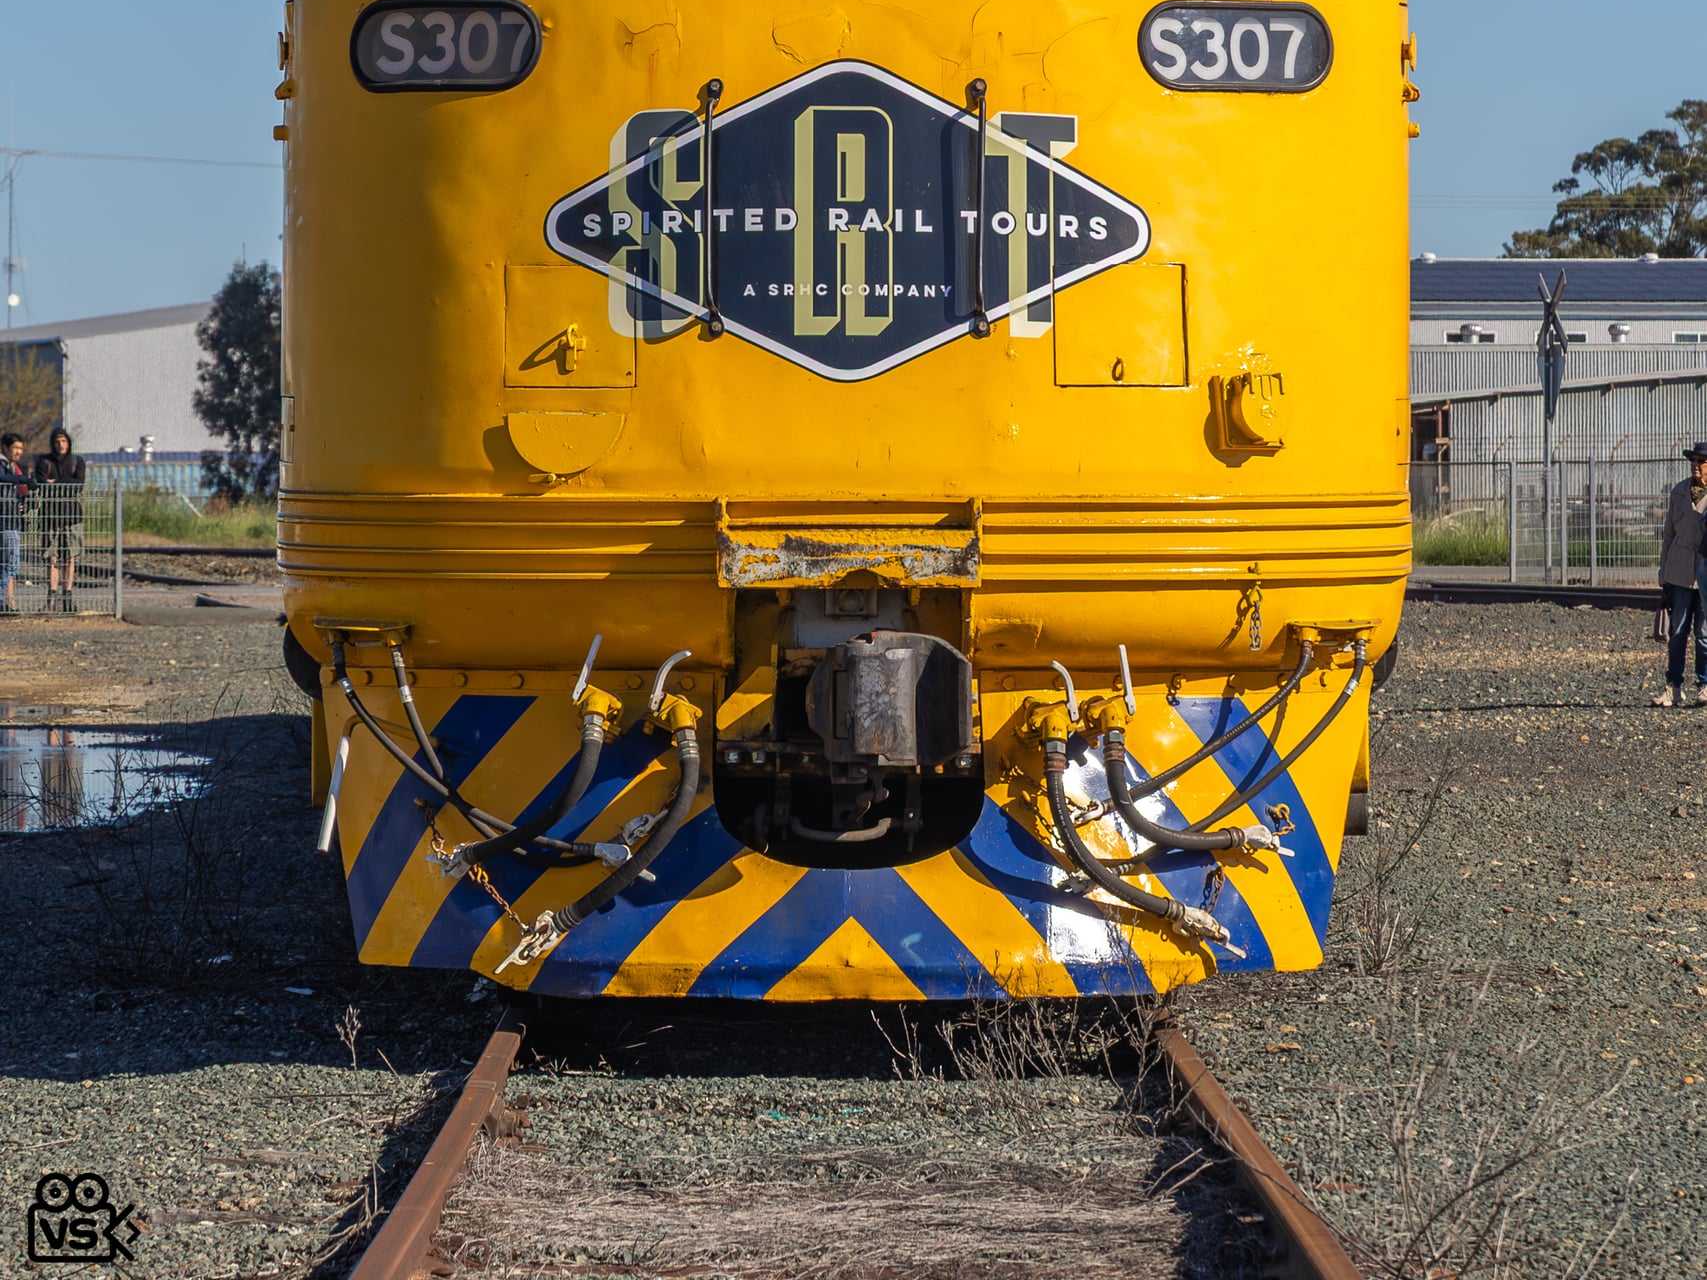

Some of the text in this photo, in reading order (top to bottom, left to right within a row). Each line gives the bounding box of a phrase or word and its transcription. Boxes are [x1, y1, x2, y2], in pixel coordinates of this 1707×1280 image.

[376, 10, 532, 75] S307
[1150, 16, 1307, 81] S307
[582, 207, 1108, 241] SPIRITED RAIL TOURS
[743, 283, 953, 298] A SRHC COMPANY
